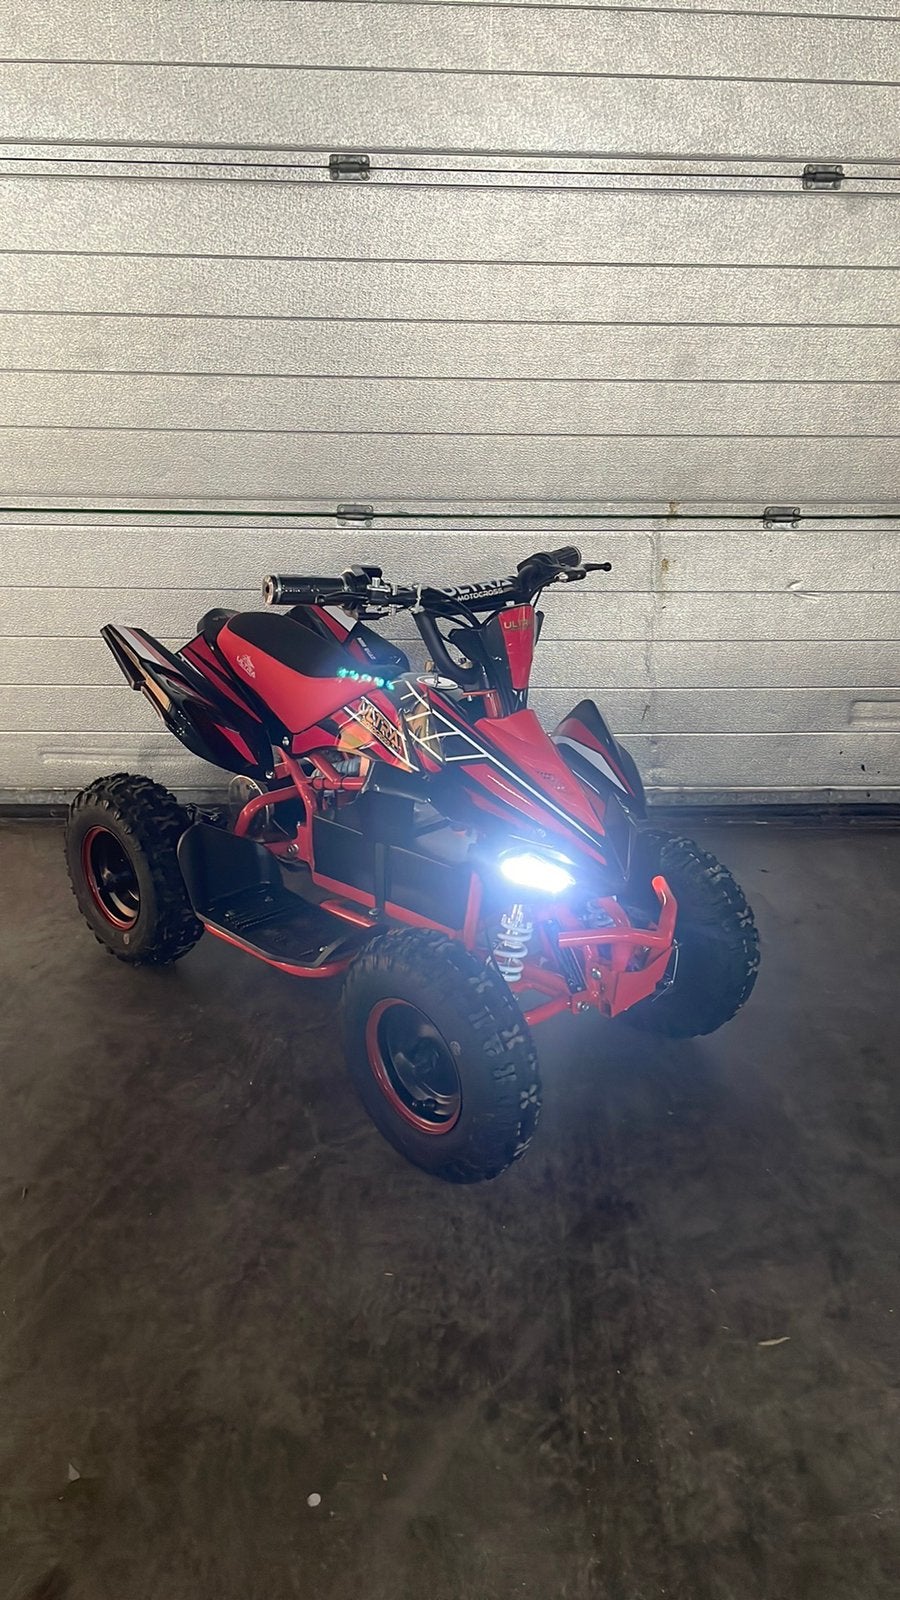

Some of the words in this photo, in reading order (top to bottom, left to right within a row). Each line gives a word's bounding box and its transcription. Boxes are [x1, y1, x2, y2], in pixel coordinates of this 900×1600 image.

[440, 579, 513, 597] ULTRA
[457, 587, 504, 602] MOTOCROSS
[358, 699, 400, 748] ULTRA
